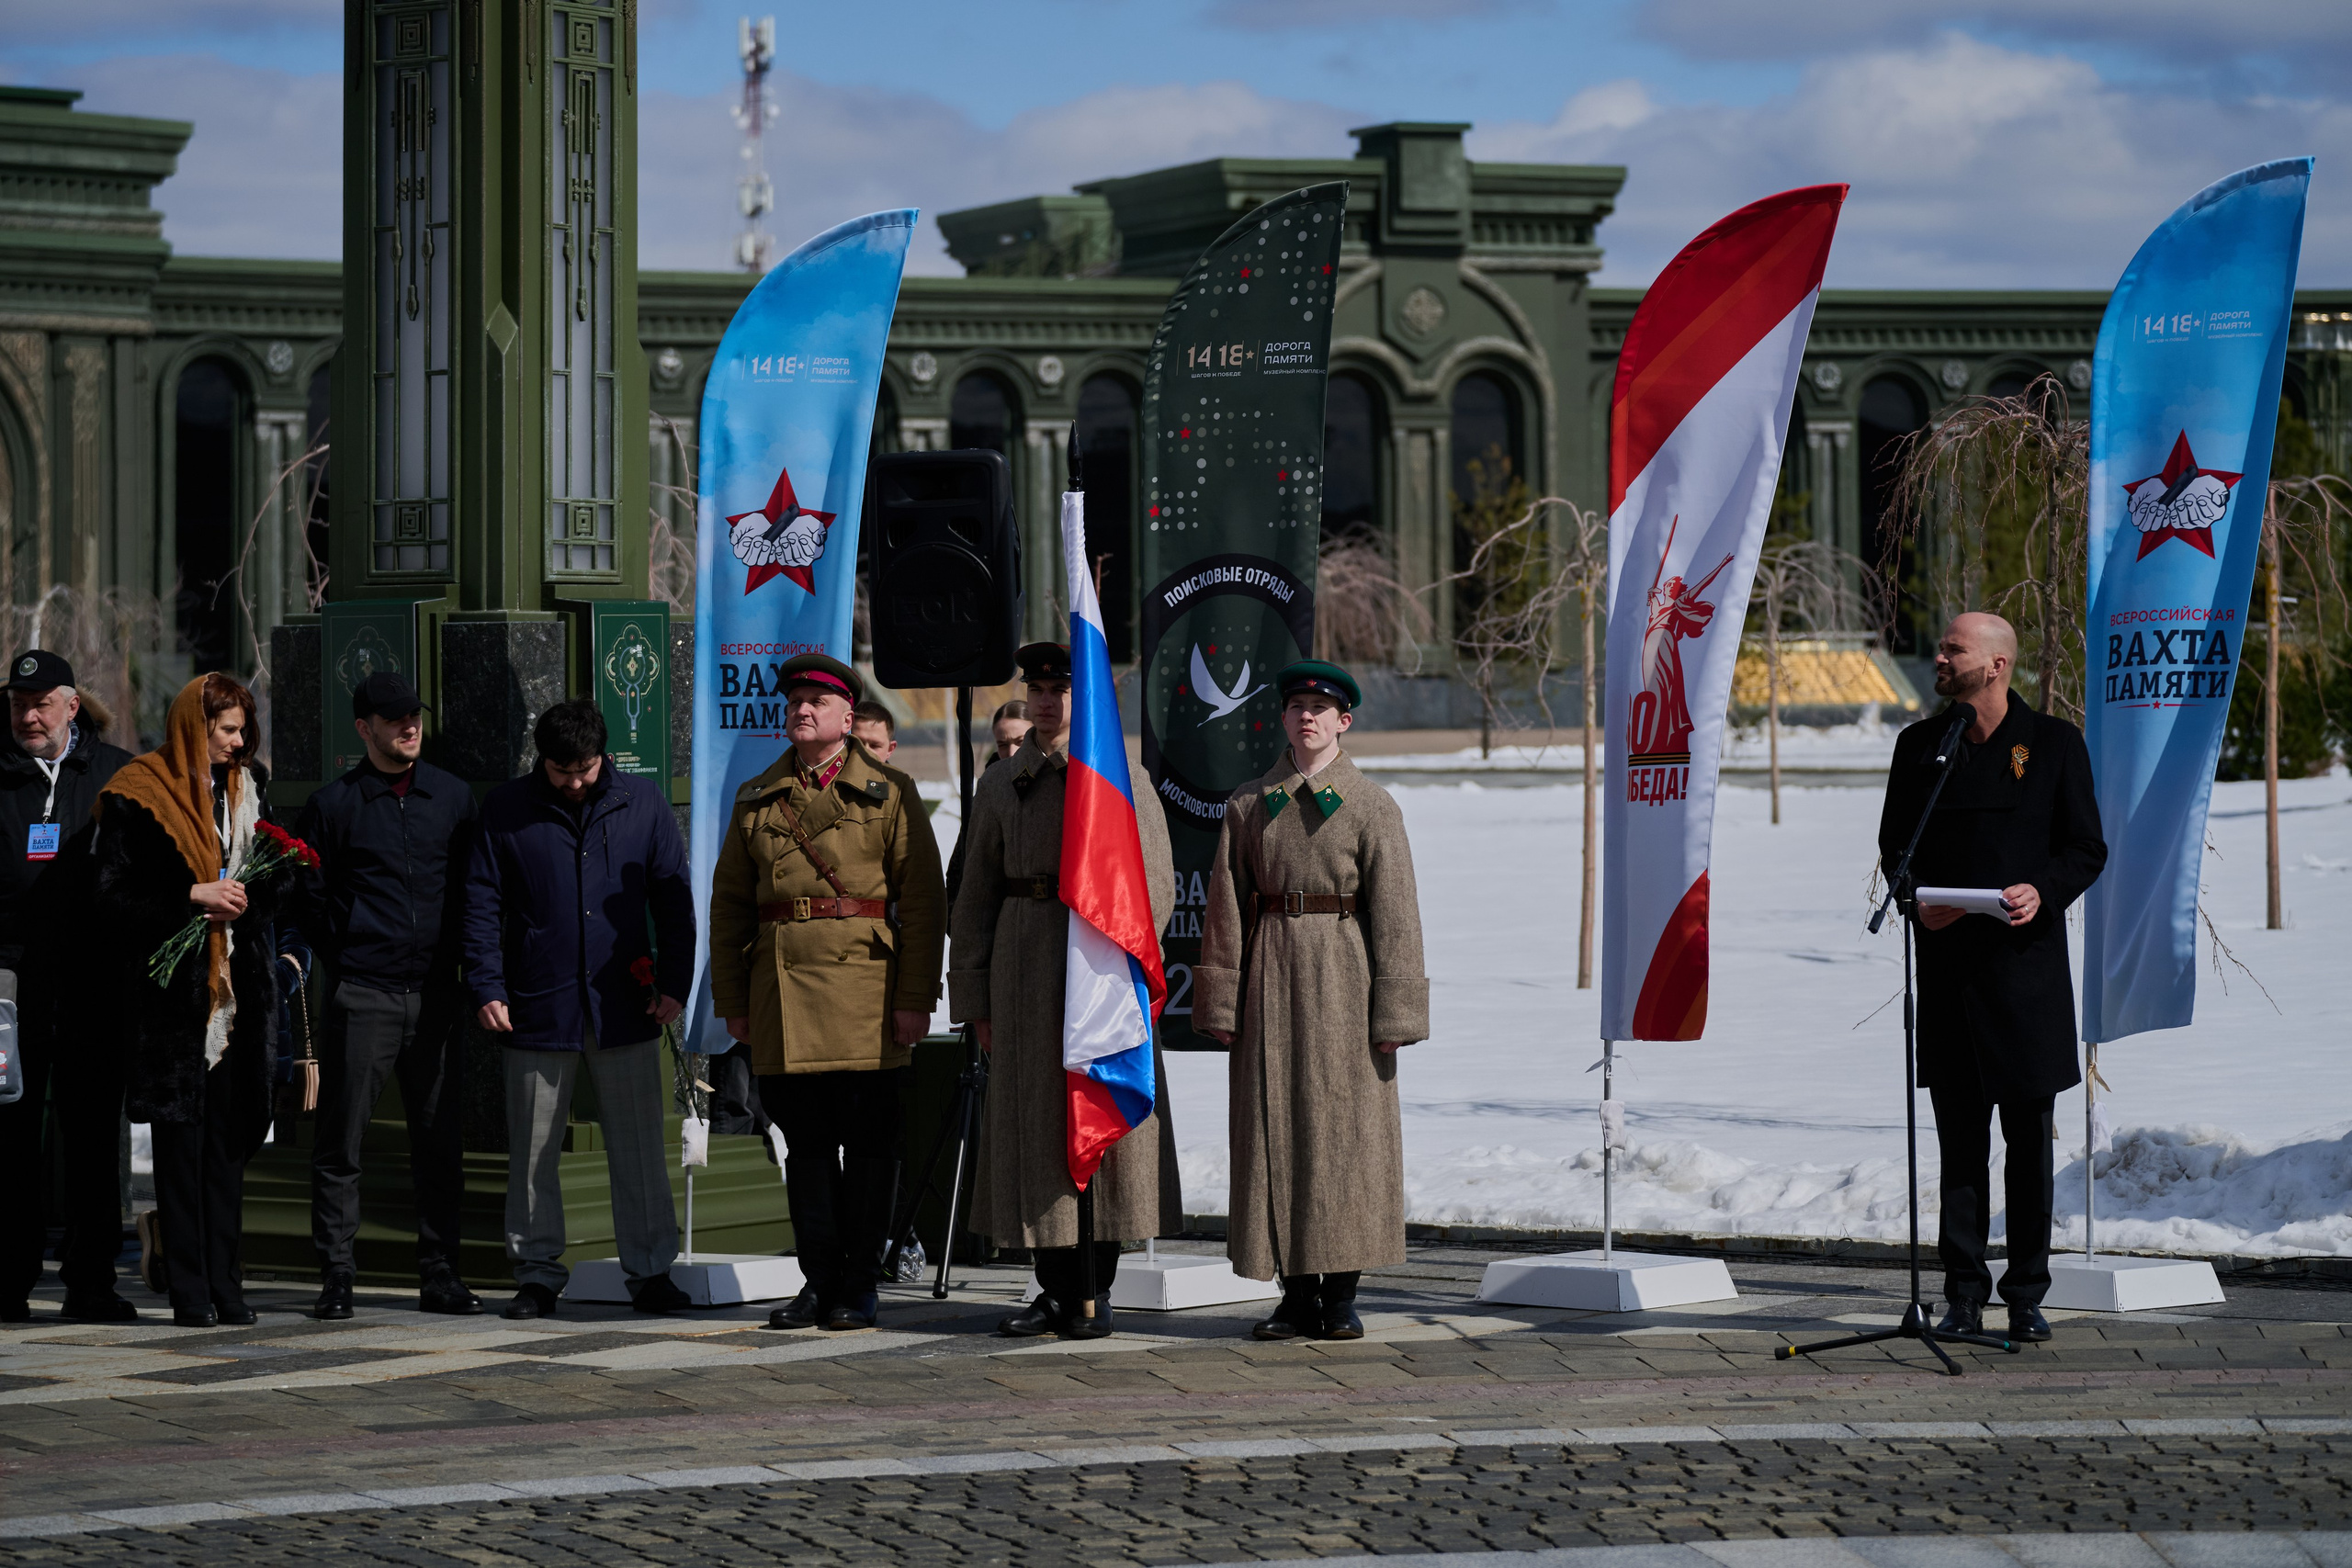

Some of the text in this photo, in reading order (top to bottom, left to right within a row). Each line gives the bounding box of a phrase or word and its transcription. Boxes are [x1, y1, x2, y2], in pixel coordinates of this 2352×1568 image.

[2208, 321, 2252, 331] ПАМЯТИ
[2210, 310, 2250, 321] ДОРОГА
[1265, 342, 1311, 353] ДОРОГА
[811, 367, 851, 376] ПАМЯТИ
[812, 357, 850, 366] ДОРОГА
[1264, 355, 1313, 365] ПАМЯТИ
[1163, 566, 1295, 608] ПОИСКОВЫЕ ОТРЯДЫ
[2109, 604, 2235, 627] ВСЕРОССИЙСКАЯ
[720, 640, 825, 656] ВСЕРОССИЙСКАЯ
[2107, 629, 2232, 671] ВАХТА
[2105, 671, 2230, 704] ПАМЯТИ
[719, 703, 788, 730] ПАМ
[1627, 767, 1690, 807] БЕДА!
[1174, 871, 1212, 906] ВА
[1168, 911, 1206, 938] ПА
